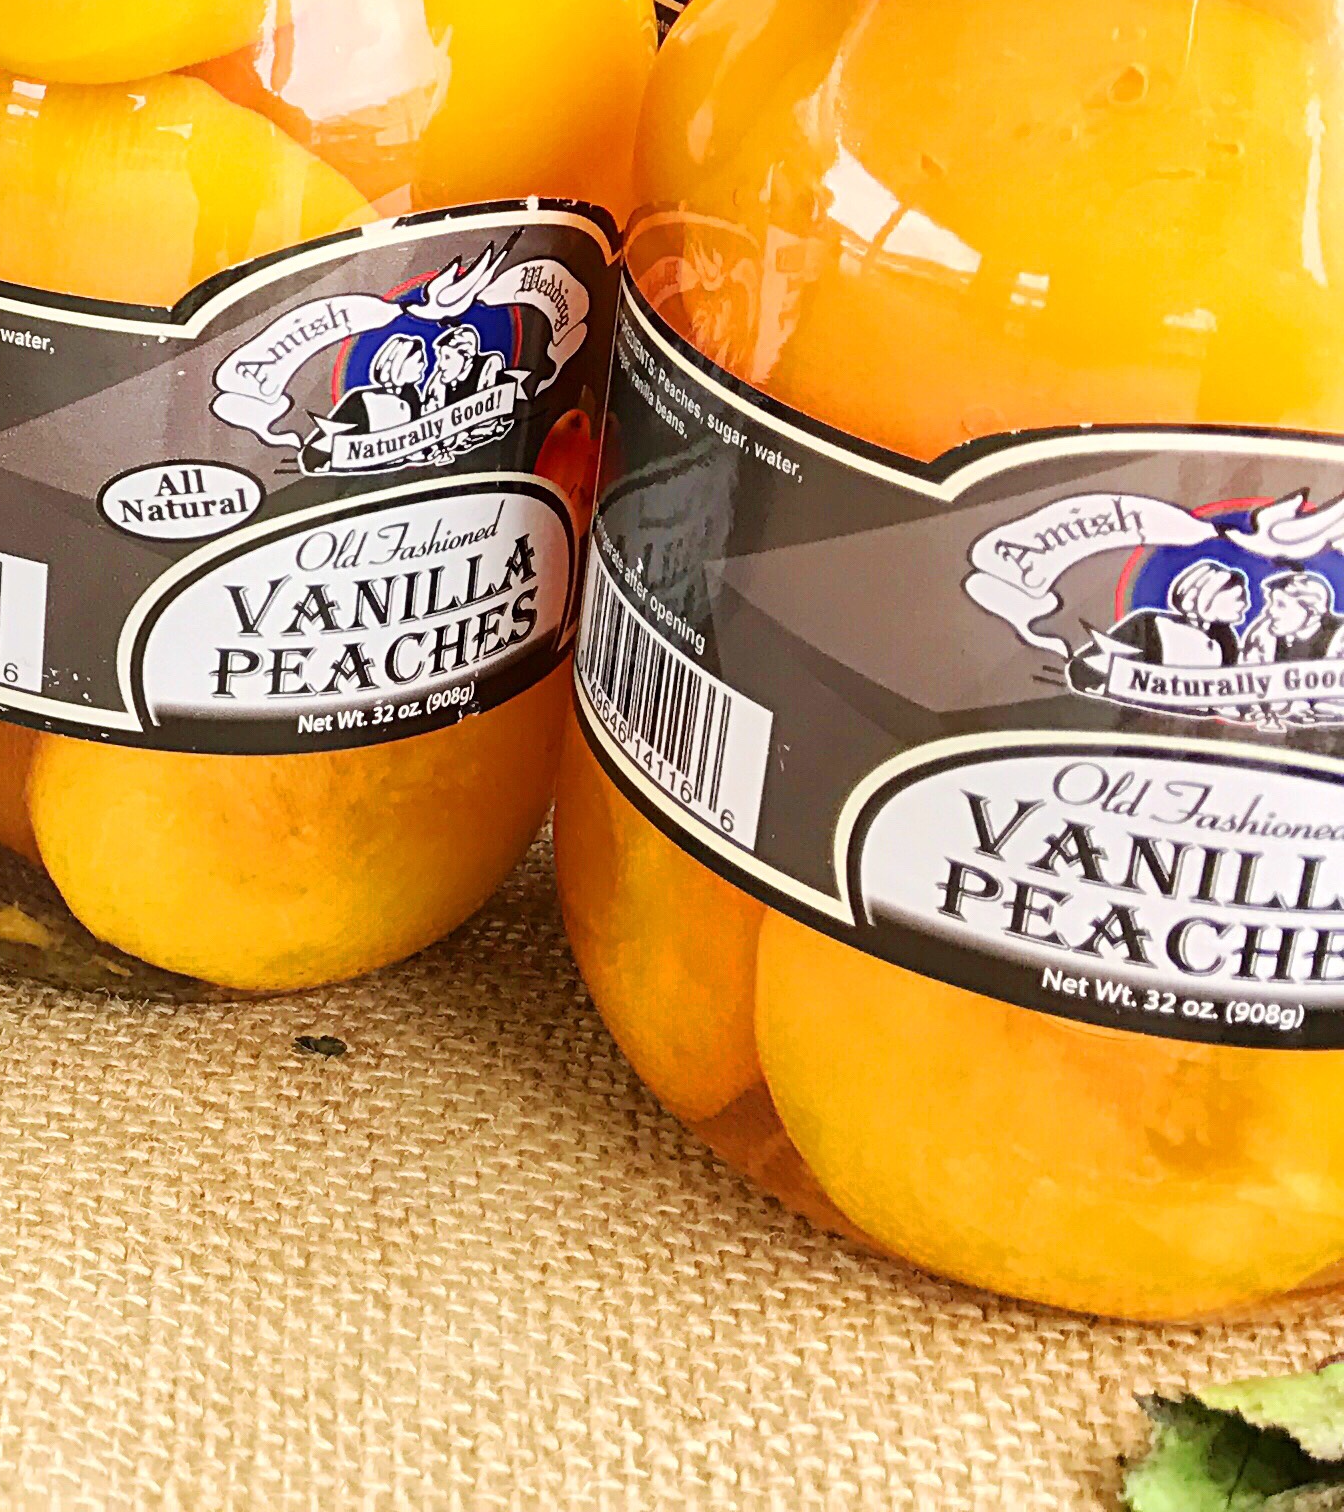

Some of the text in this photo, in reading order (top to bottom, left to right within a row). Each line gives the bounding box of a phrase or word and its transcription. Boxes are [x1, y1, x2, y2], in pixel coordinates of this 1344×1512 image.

[0, 326, 56, 356] water,
[235, 265, 570, 397] Amish Wedding
[346, 389, 504, 463] Naturally Good!
[655, 394, 688, 439] beans.
[658, 367, 704, 424] Peaches,
[706, 413, 750, 455] sugar,
[754, 441, 804, 484] water,
[117, 489, 250, 524] Natural
[153, 469, 206, 497] All
[295, 499, 506, 572] Old Fashioned
[994, 496, 1146, 588] Amish
[223, 532, 538, 638] VANILLA
[624, 566, 649, 601] after
[650, 595, 706, 656] opening
[3, 662, 19, 683] 6
[208, 586, 539, 700] PEACHES
[297, 681, 475, 734] Net Wt. 32 oz. (908g)
[1129, 668, 1272, 699] Naturally
[590, 680, 627, 744] 49646
[634, 739, 693, 804] 14116
[719, 808, 736, 833] 6
[1052, 761, 1153, 817] Old
[960, 788, 1344, 915] VANILL
[936, 856, 1344, 986] PEACHE
[1041, 967, 1306, 1032] Net Wt. 32 oz. (908g)
